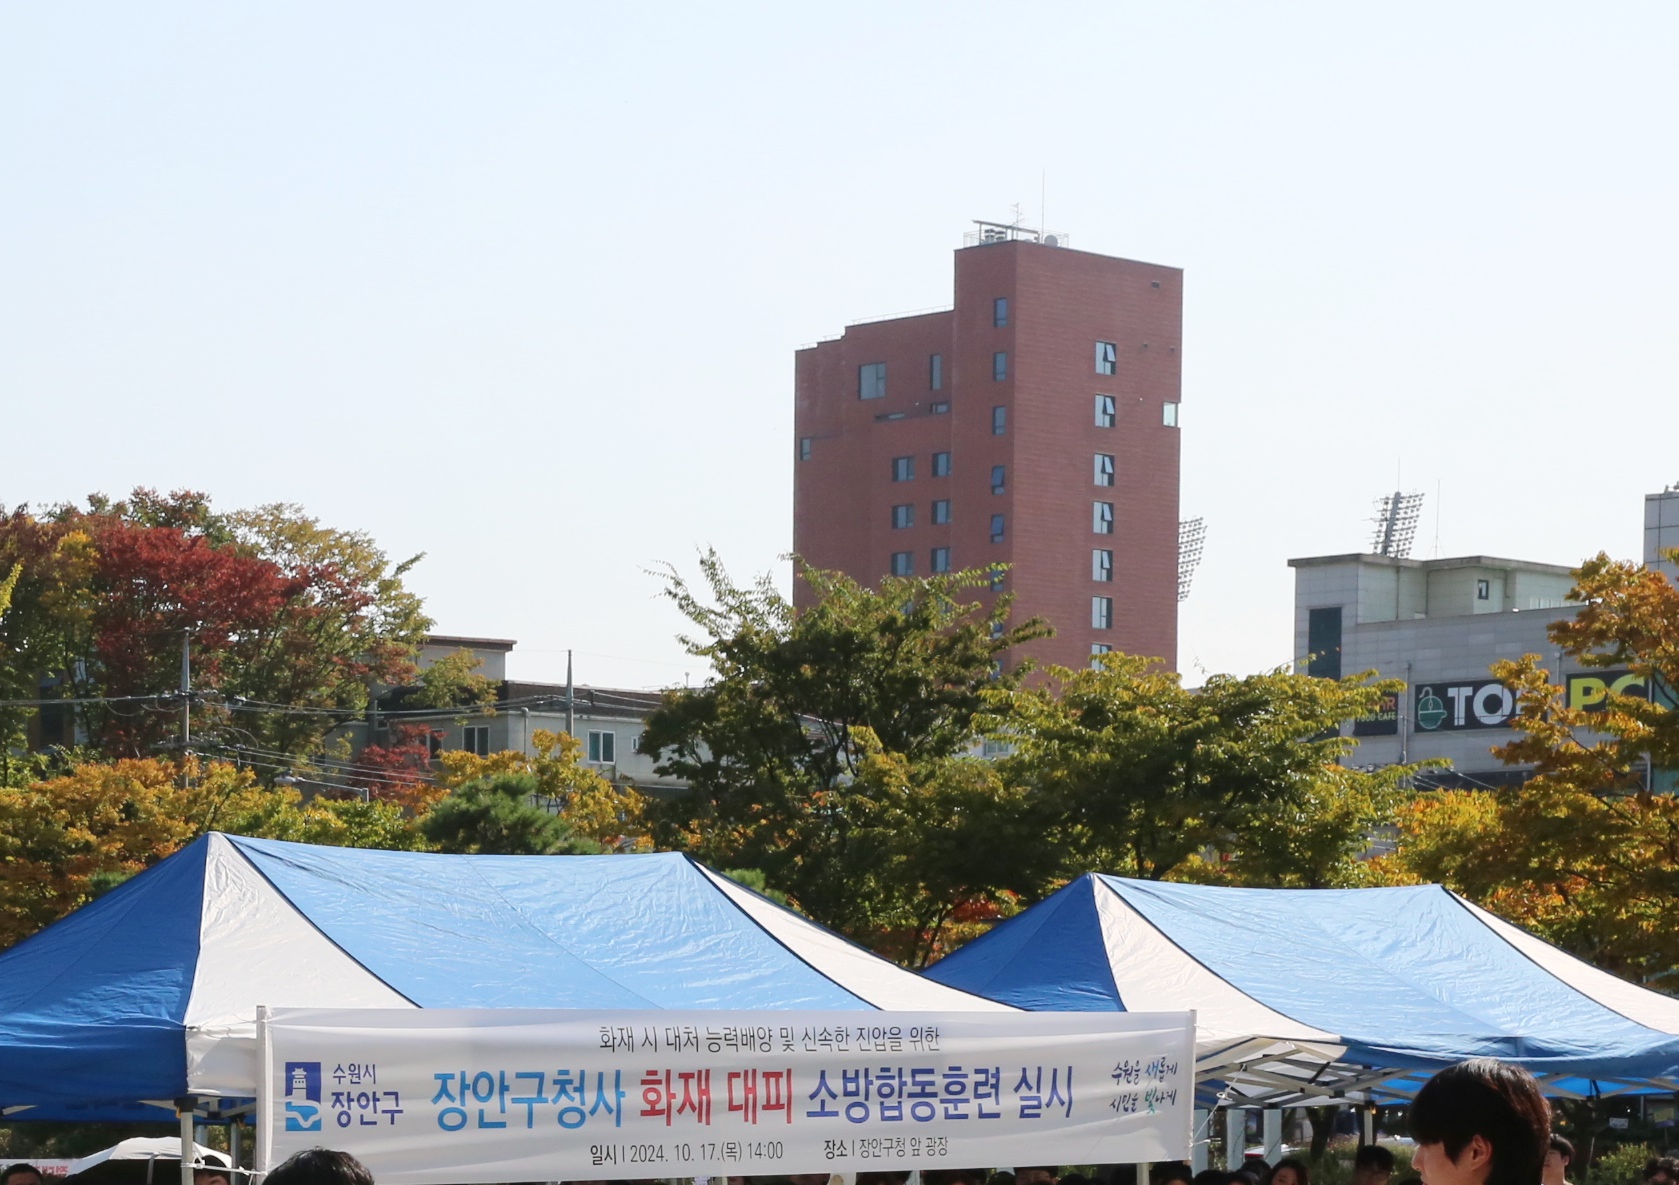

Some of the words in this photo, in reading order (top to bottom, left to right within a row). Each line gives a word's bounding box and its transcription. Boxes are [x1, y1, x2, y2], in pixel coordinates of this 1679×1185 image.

[599, 1025, 635, 1053] 화재
[641, 1026, 659, 1053] 시
[666, 1026, 700, 1053] 대처
[706, 1026, 773, 1053] 능력배양
[780, 1026, 796, 1053] 및
[801, 1026, 851, 1053] 신속한
[855, 1026, 904, 1053] 진압을
[909, 1026, 940, 1053] 위한
[332, 1063, 377, 1086] 수원시
[1111, 1060, 1141, 1086] 수원을
[1145, 1056, 1178, 1083] 새롭게
[331, 1090, 404, 1129] 장안구
[431, 1068, 626, 1132] 장안구청사
[640, 1068, 712, 1127] 화재
[727, 1067, 793, 1125] 대피
[806, 1066, 1002, 1124] 소방합동훈련
[1013, 1066, 1074, 1119] 실시
[589, 1144, 618, 1166] 일시
[629, 1145, 670, 1163] 2024.
[674, 1143, 696, 1162] 10.
[747, 1142, 784, 1160] 14:00
[823, 1138, 848, 1160] 장소
[859, 1137, 907, 1160] 장안구청
[909, 1136, 922, 1157] 앞
[925, 1136, 949, 1158] 광장
